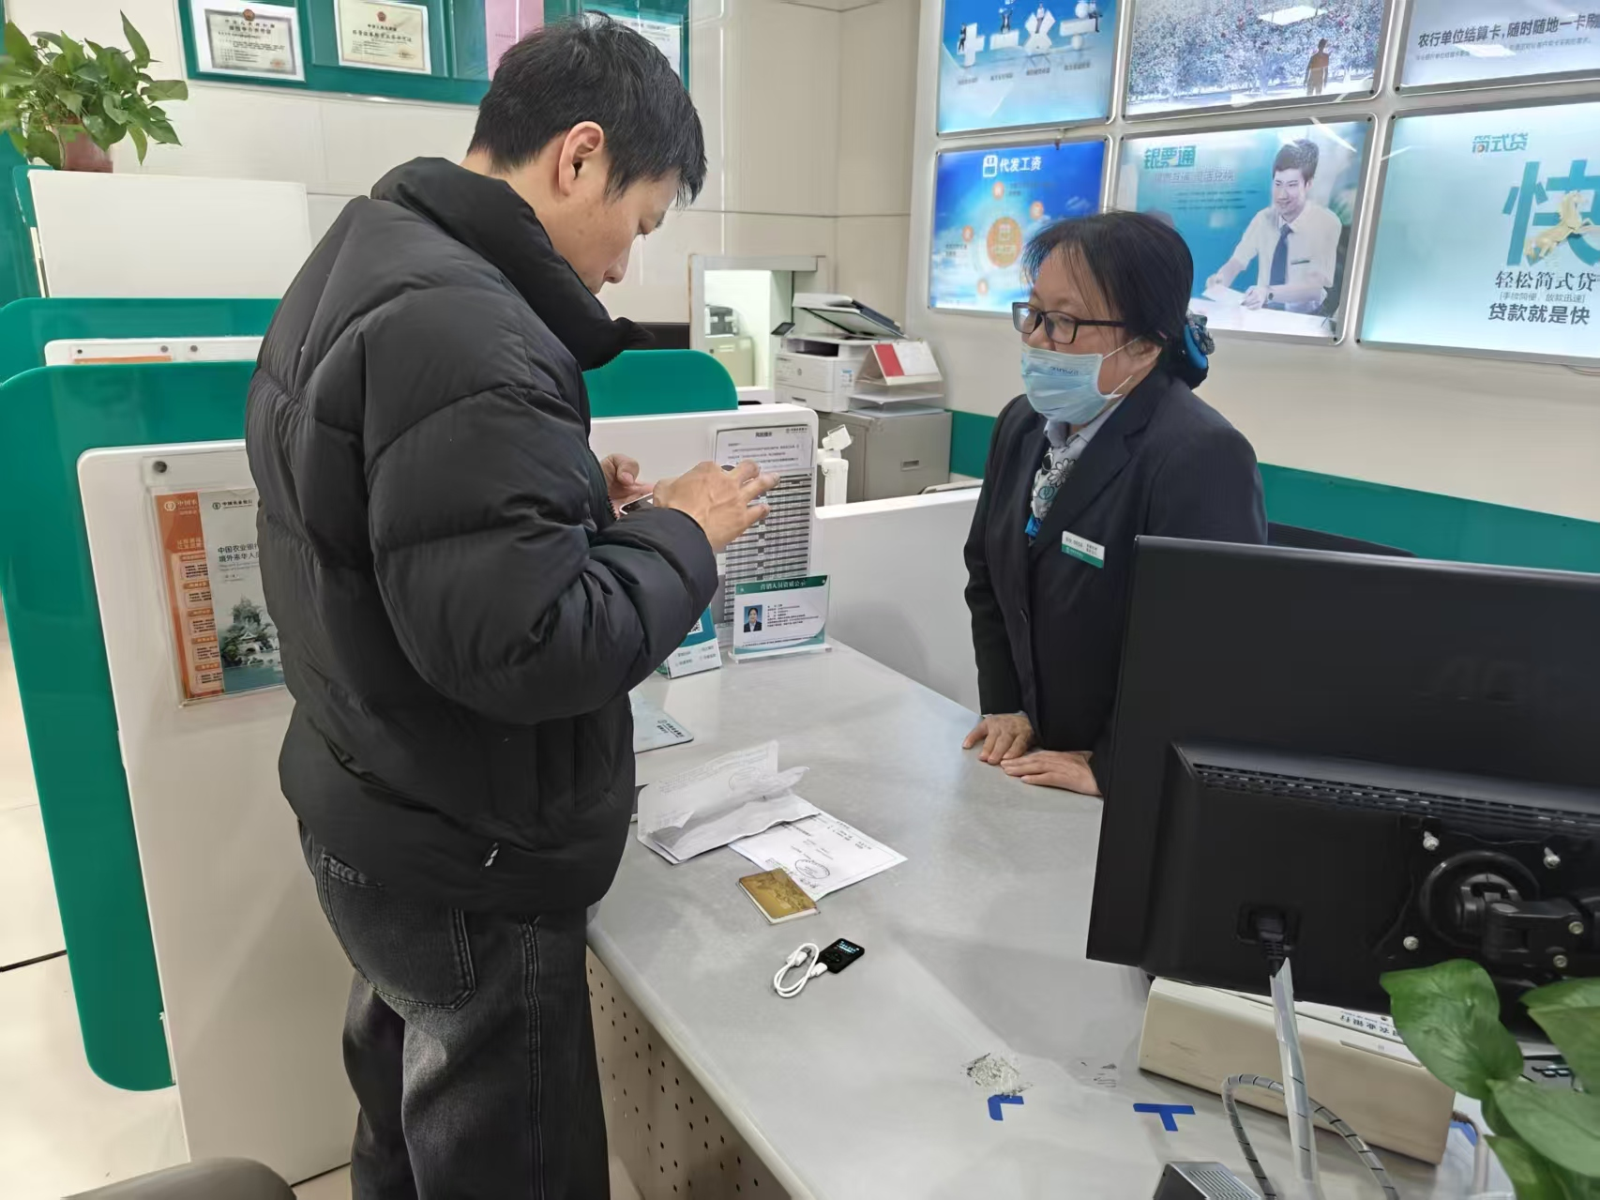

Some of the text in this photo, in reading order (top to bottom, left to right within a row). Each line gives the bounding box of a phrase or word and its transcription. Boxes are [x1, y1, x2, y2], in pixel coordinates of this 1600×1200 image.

[1472, 132, 1529, 154] 简式贷
[999, 156, 1042, 173] 代发工资
[1143, 144, 1197, 170] 银票通
[1494, 270, 1597, 292] 轻松简式贷
[1488, 302, 1591, 326] 贷款就是快
